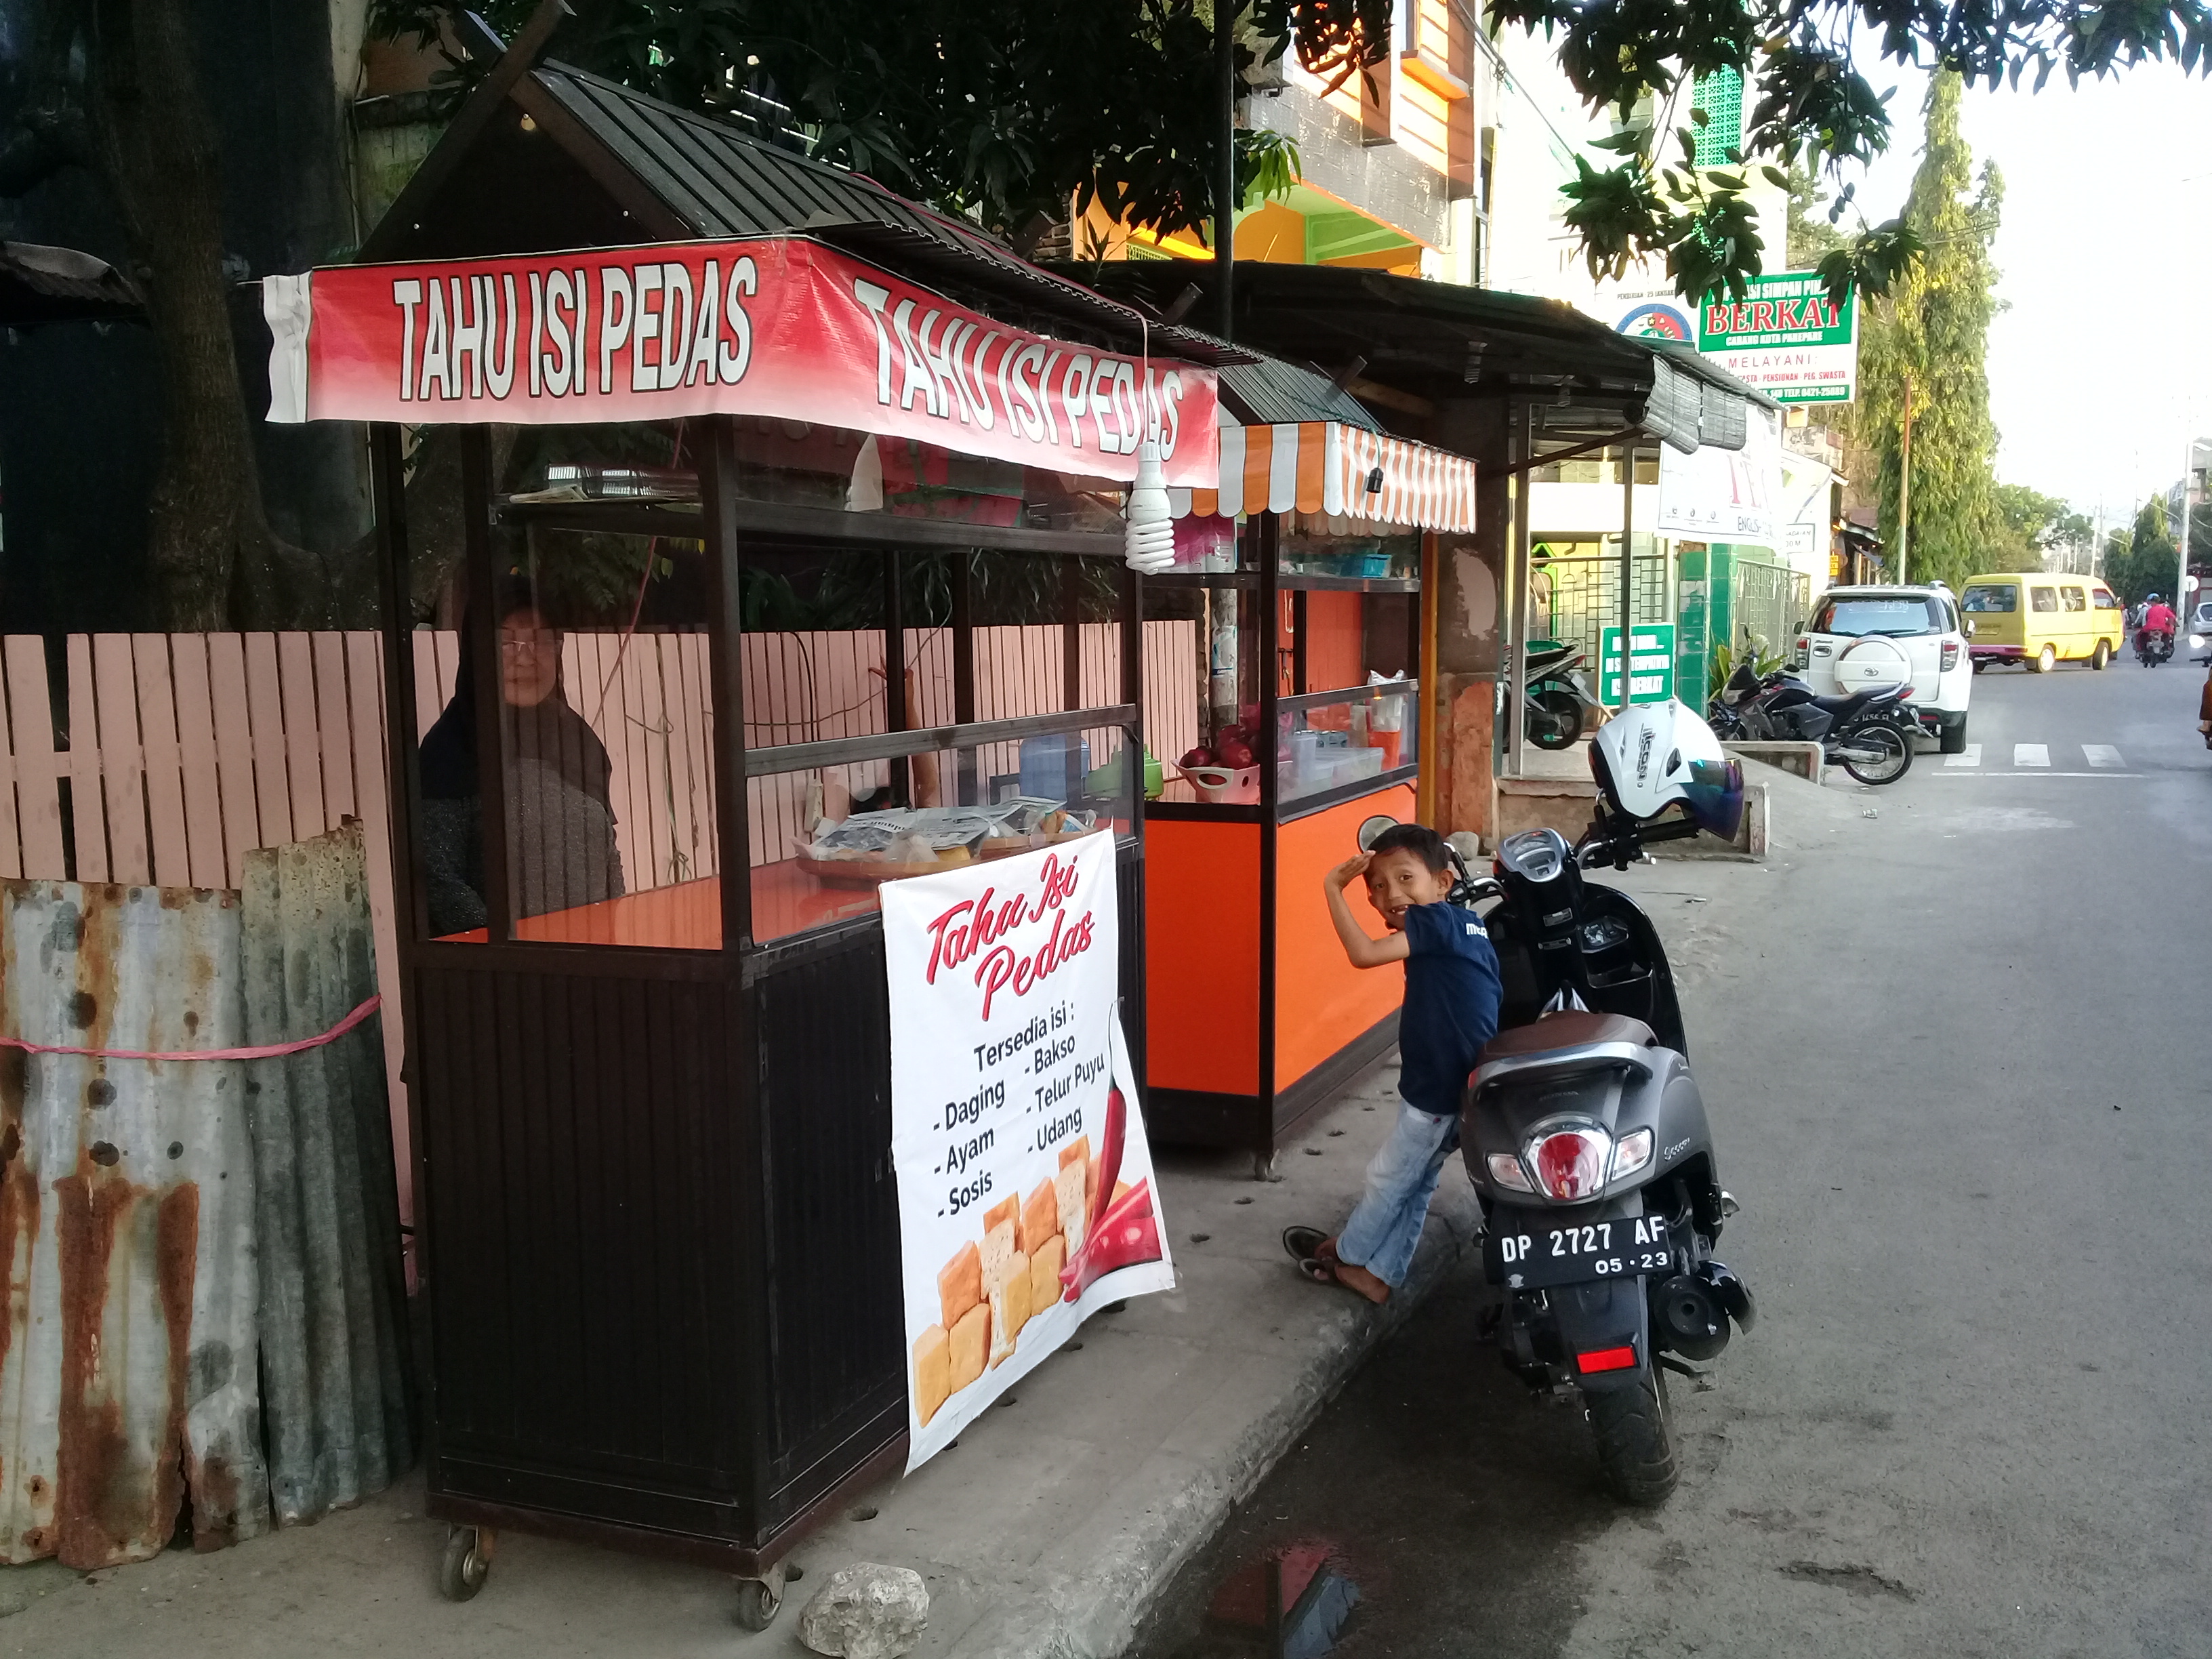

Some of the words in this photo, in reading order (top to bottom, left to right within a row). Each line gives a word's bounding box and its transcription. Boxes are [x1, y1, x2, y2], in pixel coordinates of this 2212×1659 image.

[393, 272, 518, 401] TAHU
[529, 268, 588, 397] ISI
[599, 256, 758, 394] PEDAS
[1705, 297, 1843, 336] BERKAT
[853, 276, 999, 431] TAHU
[997, 336, 1060, 445] ISI
[1062, 354, 1183, 462] PEDAS
[1818, 371, 1845, 380] SWASTA
[926, 886, 1028, 985] Tahu
[1028, 853, 1078, 922] Isi
[975, 909, 1095, 1021] Pedas
[974, 1015, 1047, 1072] Tersedia
[1075, 1053, 1105, 1088] Puyu
[1501, 1235, 1532, 1263] DP
[1549, 1223, 1612, 1256] 2727
[1635, 1216, 1664, 1245] AF
